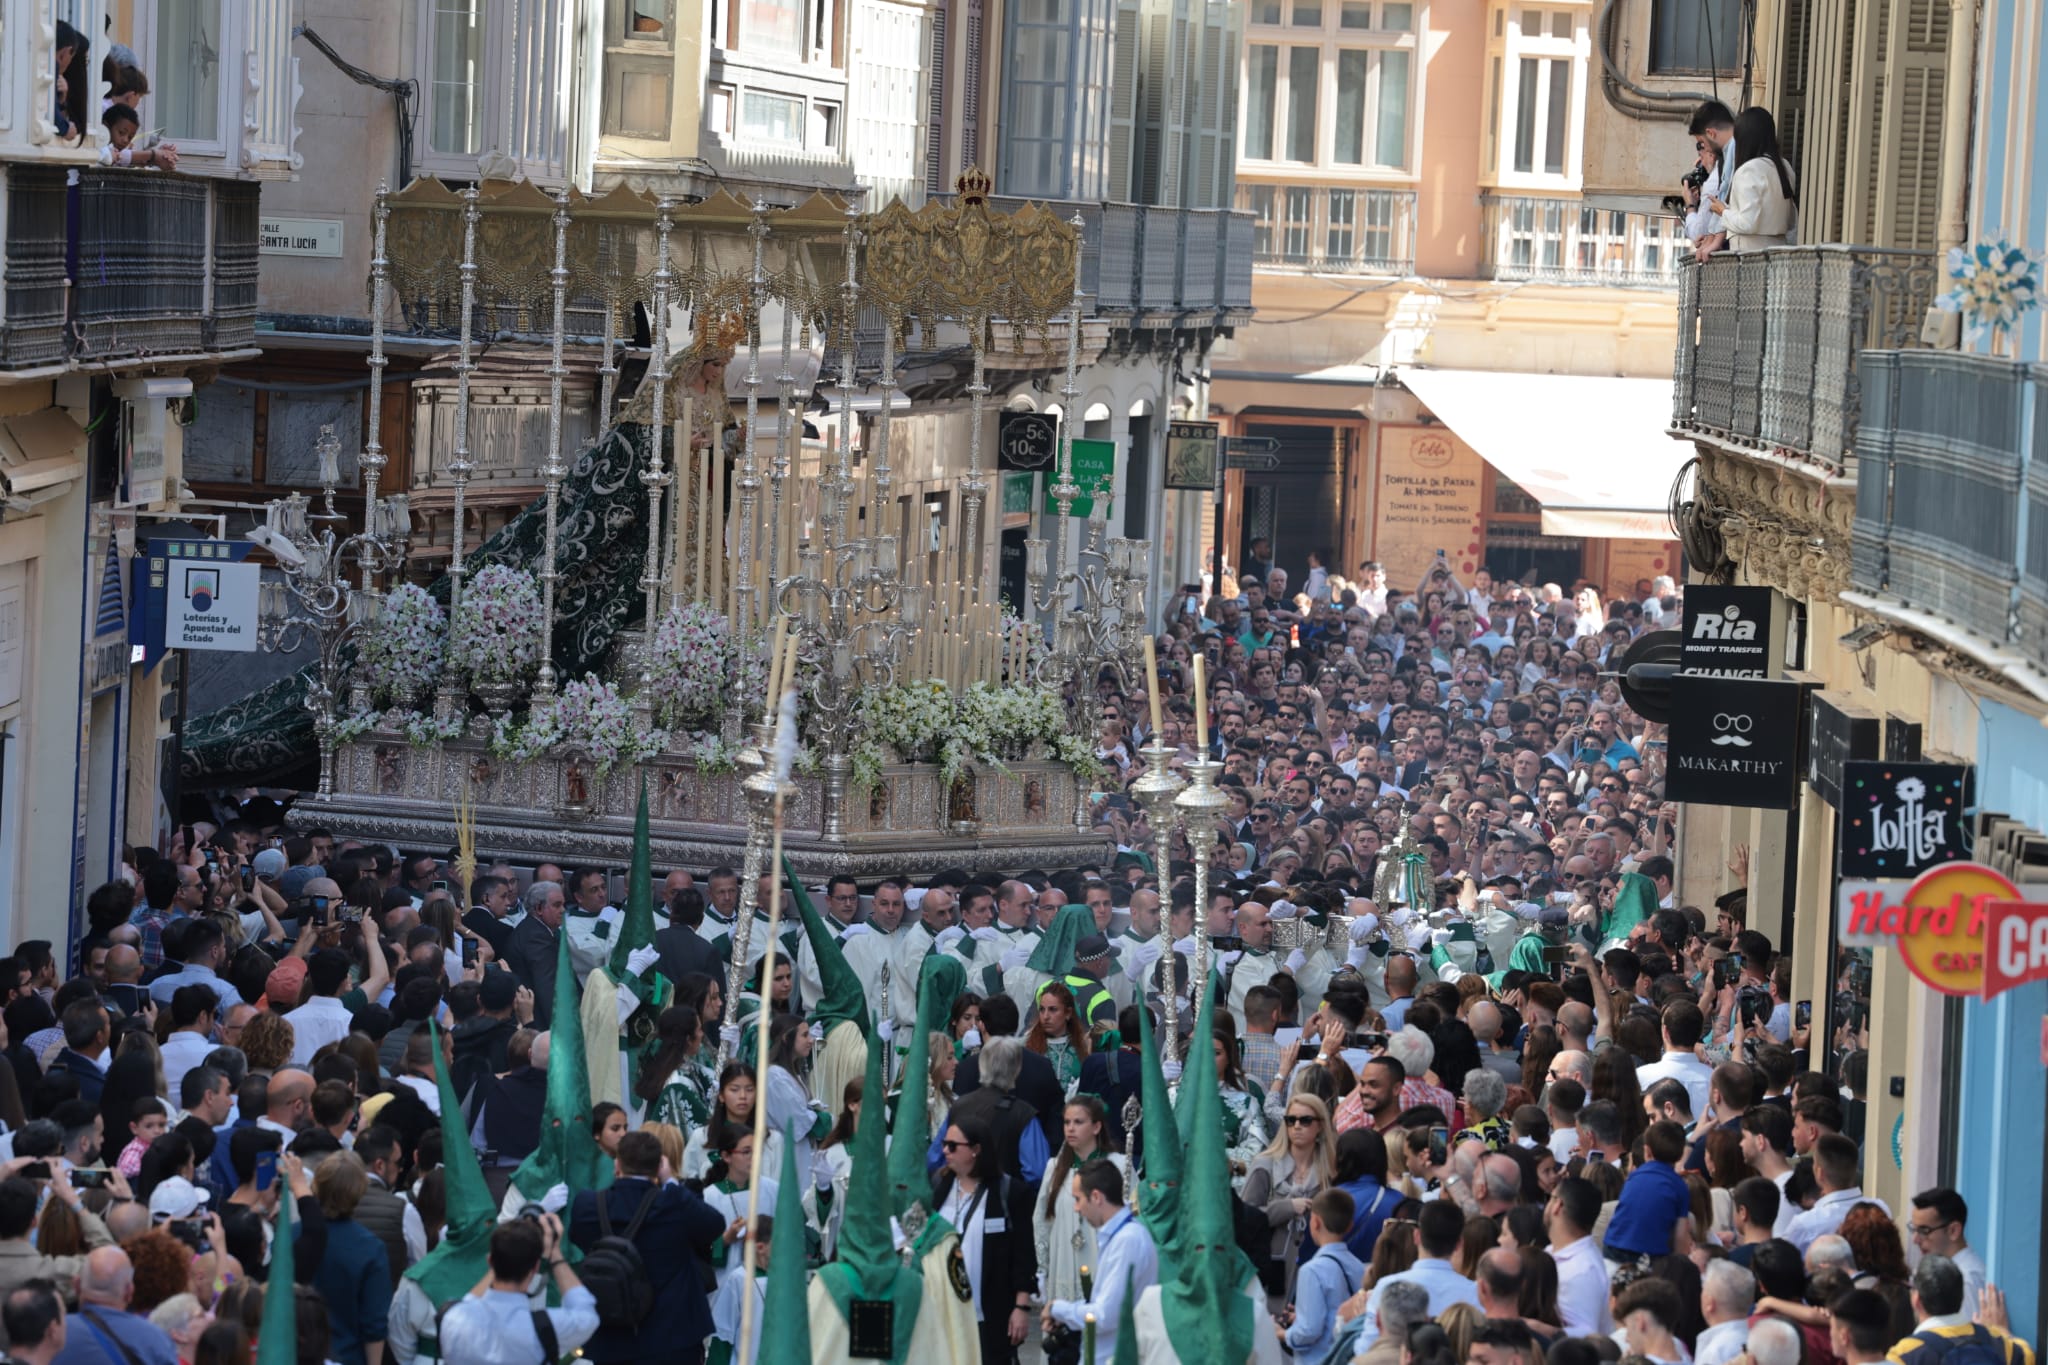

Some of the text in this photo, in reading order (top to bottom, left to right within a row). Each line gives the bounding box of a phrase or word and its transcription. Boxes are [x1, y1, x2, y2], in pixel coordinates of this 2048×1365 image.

[260, 224, 279, 233] CALLE
[260, 235, 289, 248] SANTA
[1078, 459, 1105, 469] CASA
[1385, 474, 1428, 485] TORTILLA
[1443, 476, 1475, 487] PATATA
[1403, 487, 1456, 497] AL MOMENTO
[1389, 501, 1418, 511] TOMATE
[222, 616, 228, 625] y
[1692, 604, 1757, 640] Ria
[183, 623, 241, 634] Apuestas del
[183, 634, 214, 643] Estado
[1685, 645, 1763, 654] MONEY TRANSFER
[1846, 890, 1963, 937] Hard
[1932, 952, 1982, 973] CAF
